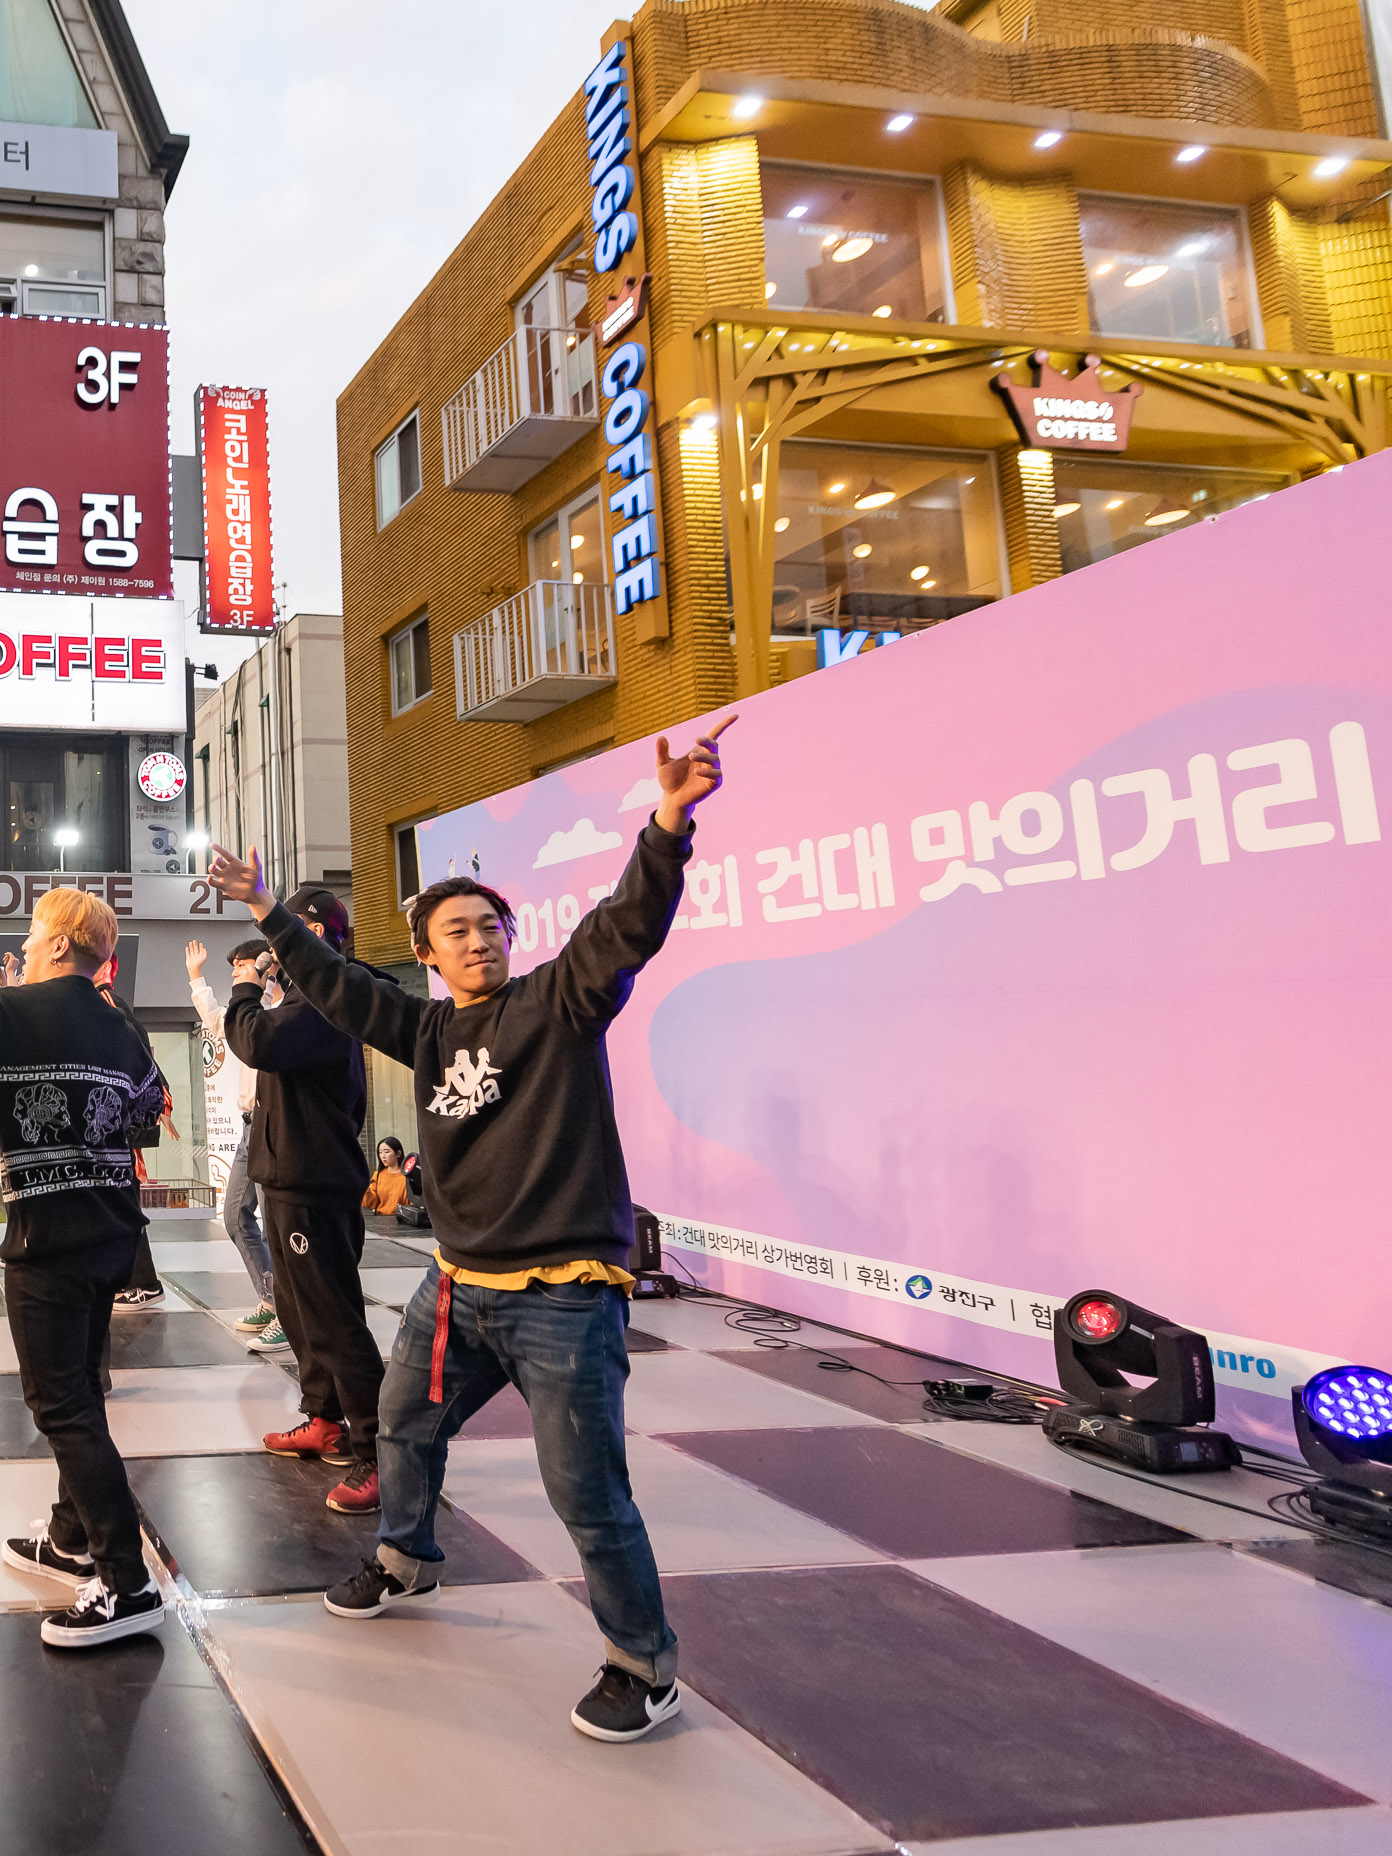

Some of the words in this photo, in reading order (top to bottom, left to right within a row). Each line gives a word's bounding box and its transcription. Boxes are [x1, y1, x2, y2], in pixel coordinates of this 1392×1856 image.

[584, 41, 635, 273] KINGS
[75, 346, 142, 404] 3F
[224, 389, 246, 400] COIN
[216, 399, 254, 410] ANGEL
[1033, 397, 1099, 420] KINGS
[1036, 418, 1118, 442] COFFEE
[602, 342, 657, 615] COFFEE
[16, 571, 41, 582] 체인점
[43, 573, 61, 583] 문의
[63, 574, 78, 585] (주)
[108, 577, 155, 588] 1588-7596
[229, 610, 254, 627] 3F
[910, 721, 1382, 903] 맛의거리
[755, 822, 897, 923] 건대
[682, 1225, 706, 1248] 건대
[708, 1231, 759, 1260] 맛의거리
[762, 1245, 834, 1279] 상가번영회
[938, 1286, 996, 1312] 광진구
